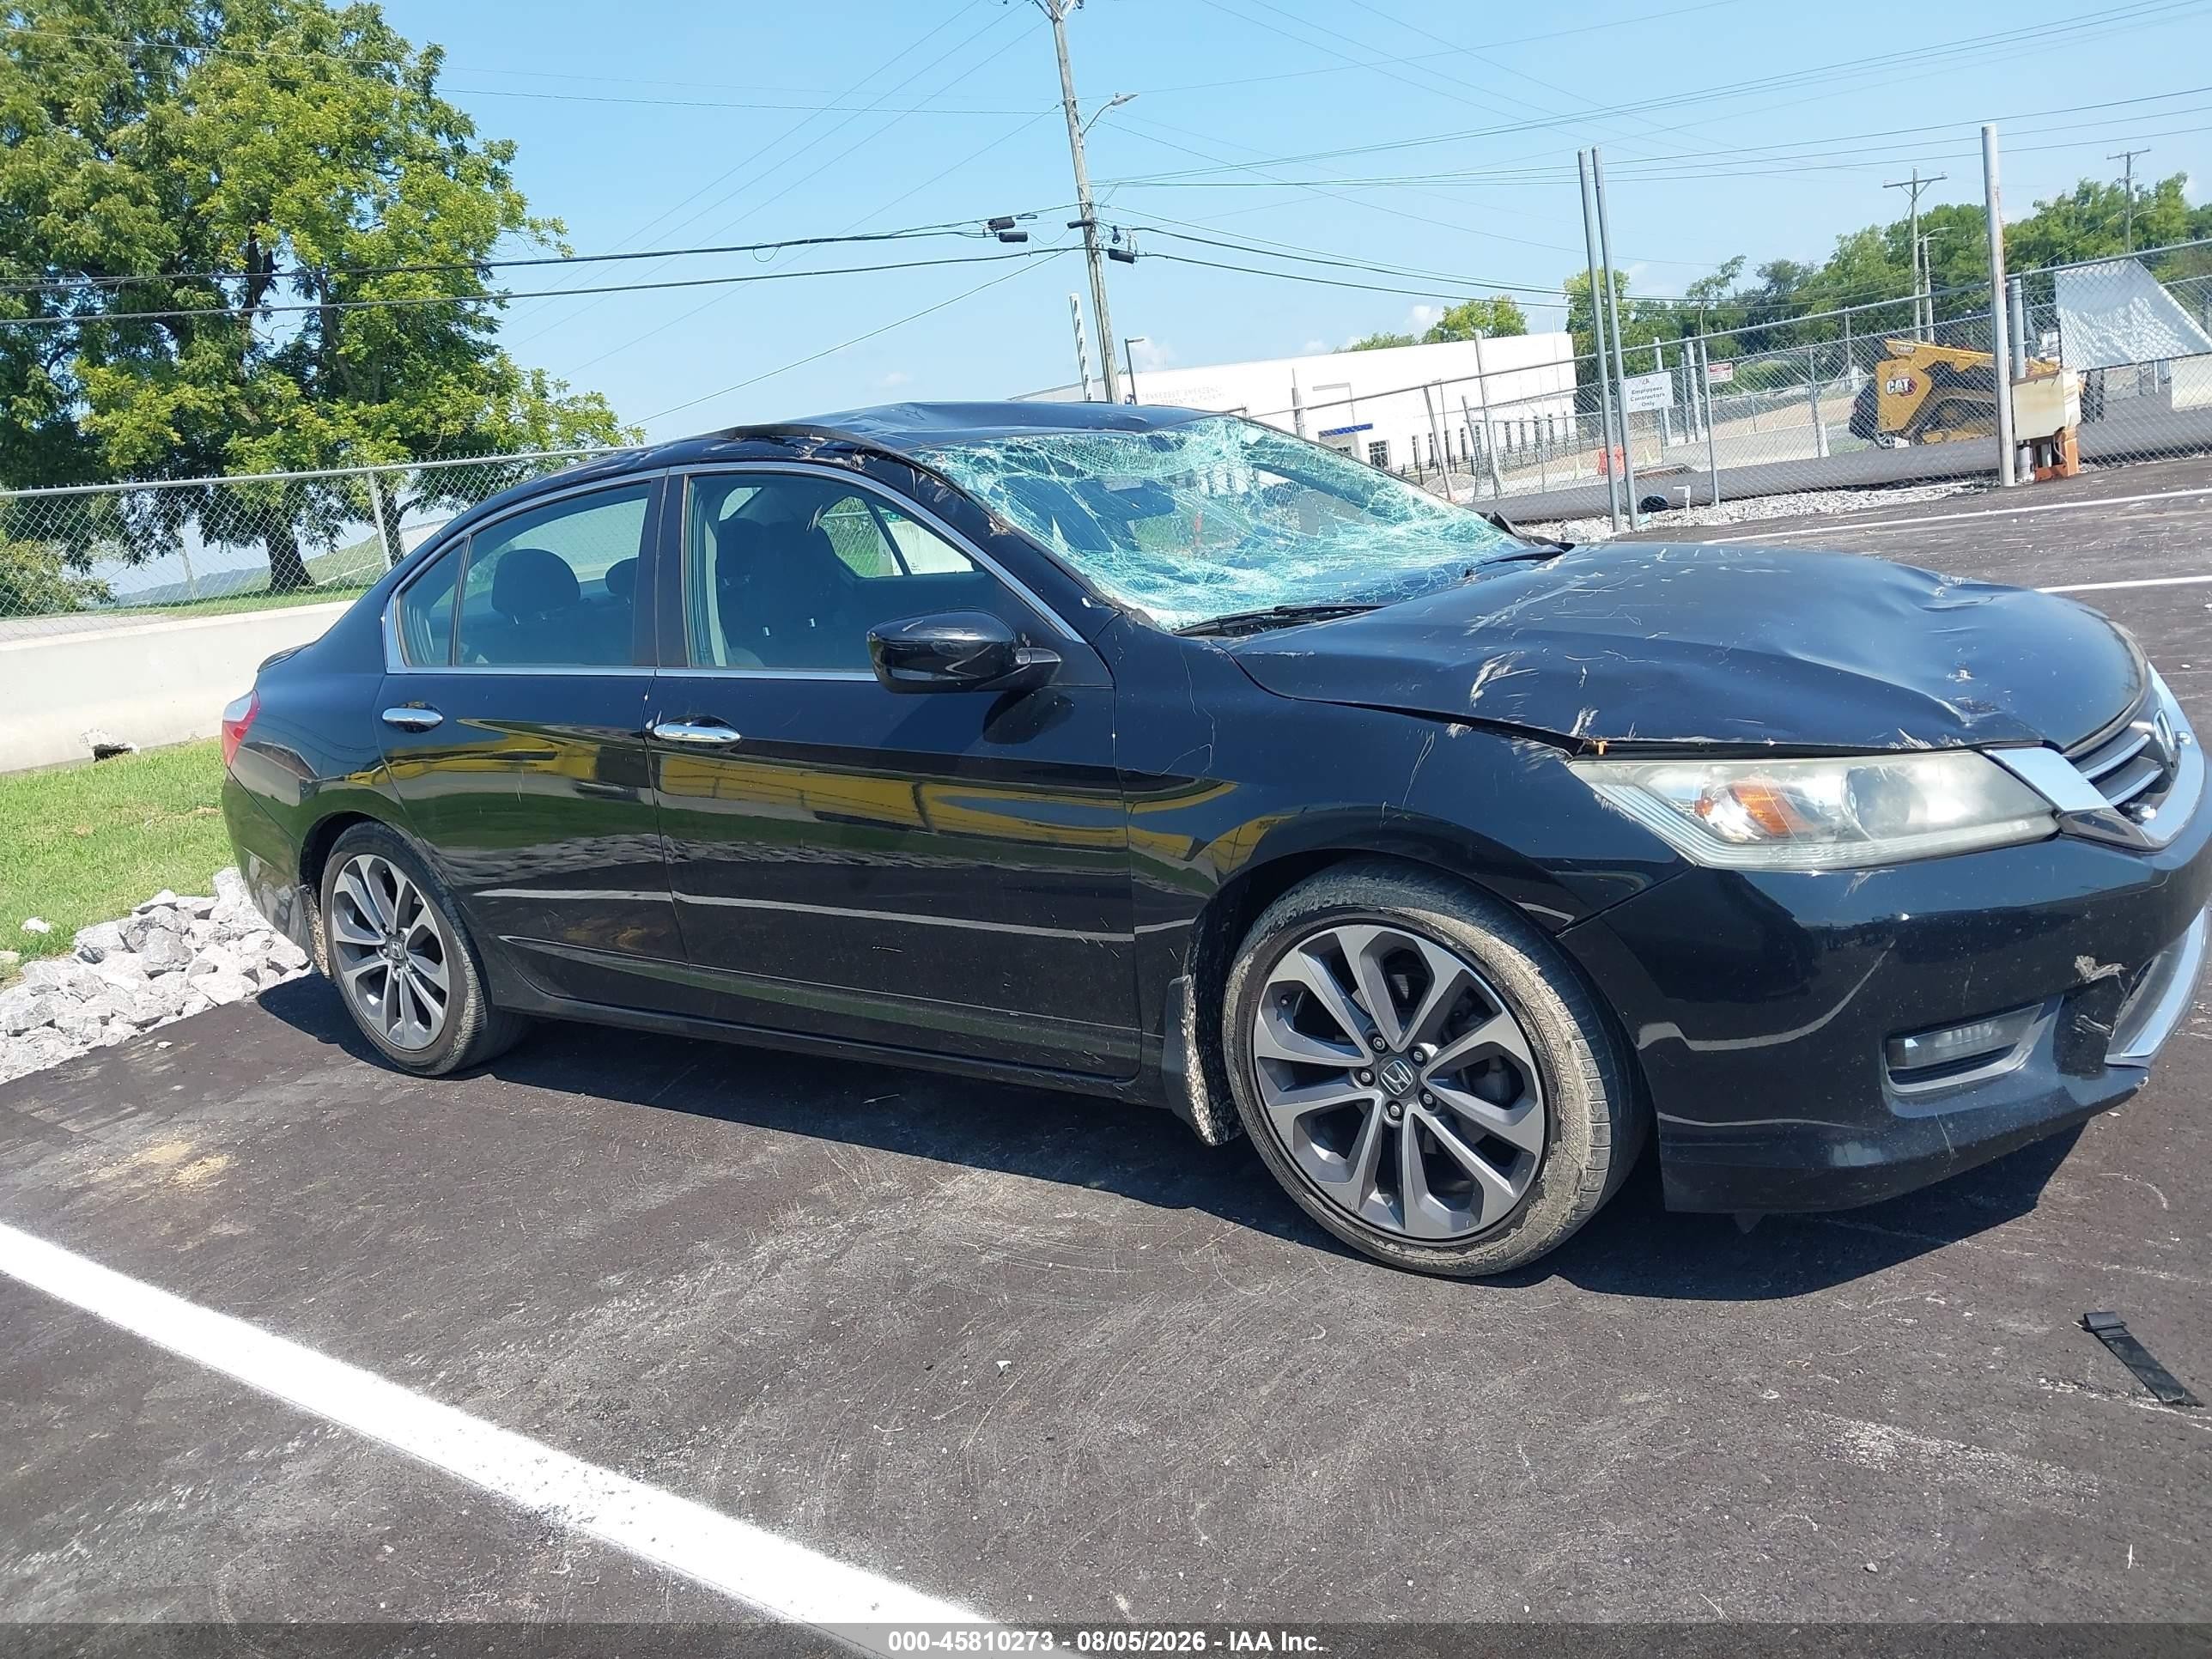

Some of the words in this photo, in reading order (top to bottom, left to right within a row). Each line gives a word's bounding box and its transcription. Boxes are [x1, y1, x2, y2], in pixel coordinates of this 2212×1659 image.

[1632, 386, 1662, 395] Employees
[1887, 378, 1911, 394] CAT
[1630, 392, 1666, 402] Contractors
